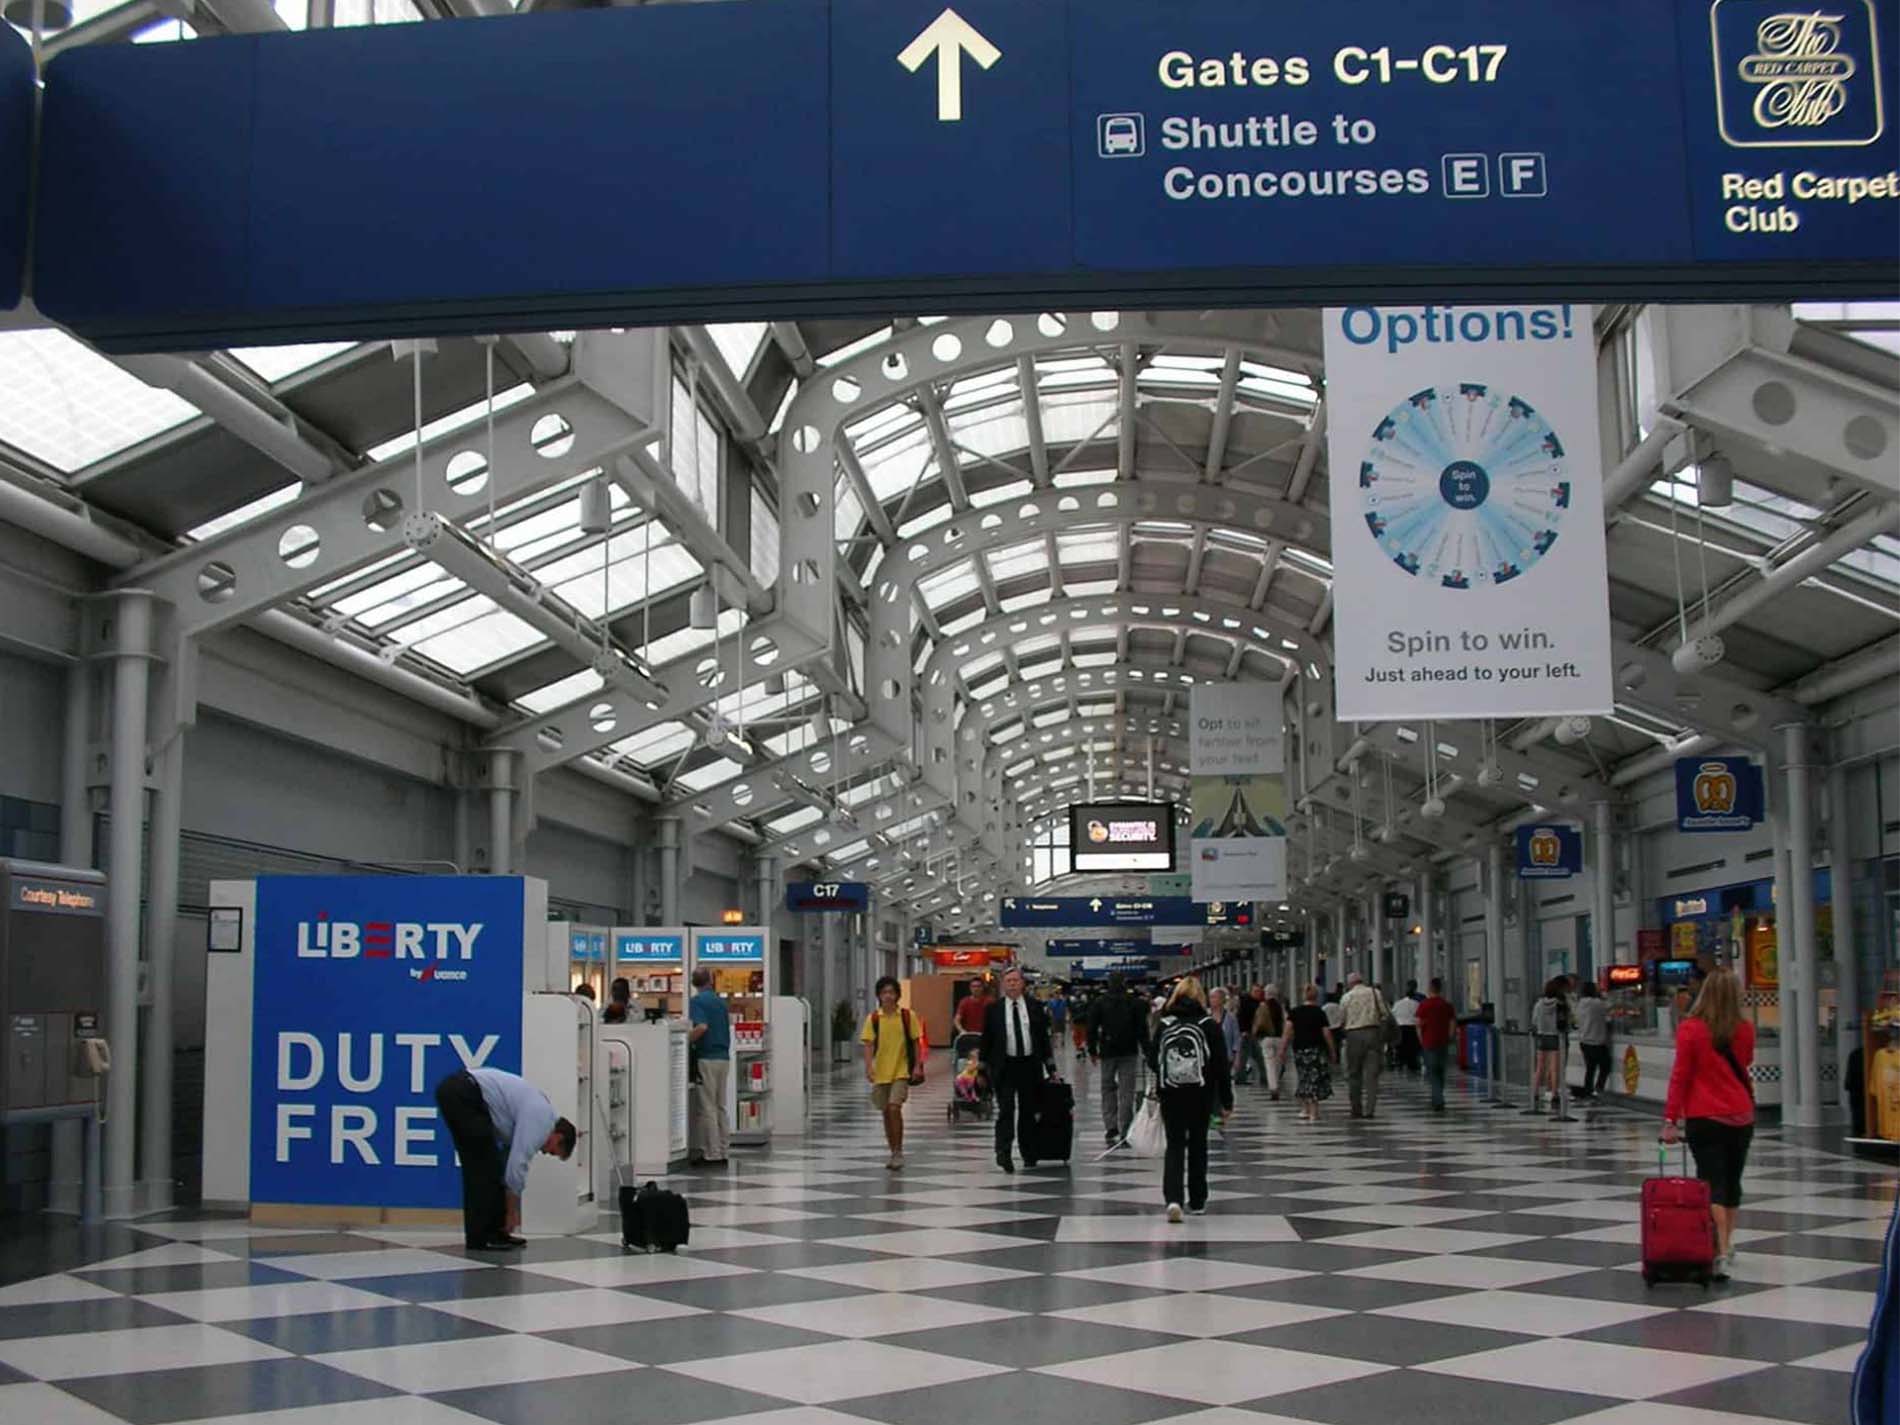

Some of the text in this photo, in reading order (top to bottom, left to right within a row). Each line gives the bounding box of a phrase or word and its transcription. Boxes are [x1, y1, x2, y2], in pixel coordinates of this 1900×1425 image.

[1757, 9, 1846, 57] The
[1158, 45, 1507, 88] Gates C1-C17
[1753, 61, 1839, 75] RED CARPET
[1753, 78, 1847, 128] Club
[1161, 113, 1376, 150] Shuttle to
[1164, 159, 1535, 200] Concourses E F
[1722, 171, 1900, 204] Red Carpet
[1725, 205, 1799, 232] Club
[1341, 304, 1573, 353] Options!
[1387, 627, 1555, 657] Spin to win.
[1364, 662, 1581, 683] Just ahead to your left.
[1198, 717, 1223, 731] Opt
[21, 886, 57, 906] Courtesy
[813, 884, 839, 897] C17
[298, 911, 483, 960] LIBERTY
[277, 1032, 500, 1093] DUTY
[276, 1103, 462, 1167] FRE
